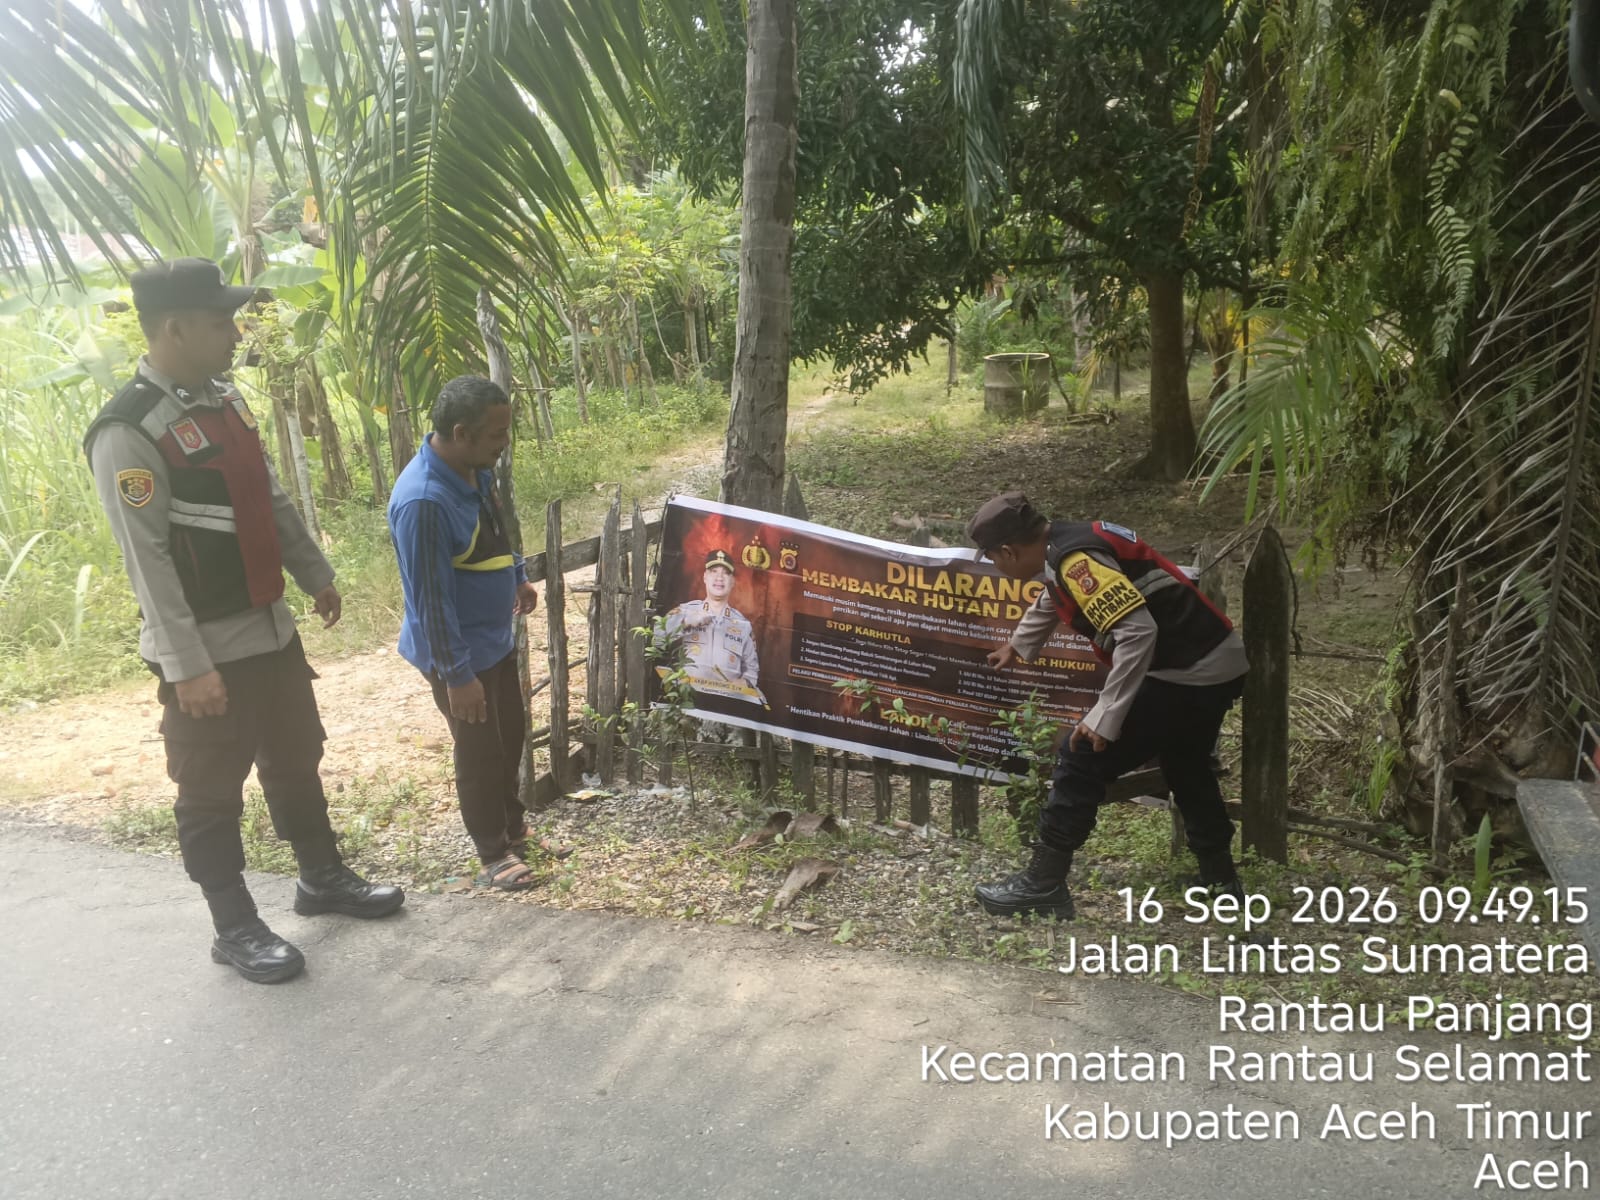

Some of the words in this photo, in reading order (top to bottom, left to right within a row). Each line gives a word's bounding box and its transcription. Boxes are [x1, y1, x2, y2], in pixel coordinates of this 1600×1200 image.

[802, 568, 918, 605] MEMBAKAR
[923, 591, 1000, 619] HUTAN
[887, 561, 1045, 604] DILARANG
[803, 590, 835, 603] Memasuki
[835, 596, 856, 607] musim
[907, 611, 947, 624] pembukaan
[948, 617, 967, 628] lahan
[968, 622, 995, 634] dengan
[1053, 632, 1075, 643] (Land
[826, 620, 853, 632] STOP
[854, 625, 912, 645] KARHUTLA
[832, 605, 859, 616] percikan
[860, 610, 870, 618] api
[893, 617, 906, 626] apa
[906, 619, 920, 628] pun
[920, 621, 940, 633] dapat
[941, 626, 969, 637] memicu
[969, 630, 1006, 643] kebakaran
[1050, 656, 1096, 672] HUKUM
[790, 706, 821, 719] Hentikan
[822, 712, 846, 723] Praktik
[846, 717, 889, 733] Pembakaran
[889, 726, 910, 737] Lahan
[977, 743, 1000, 754] Udara
